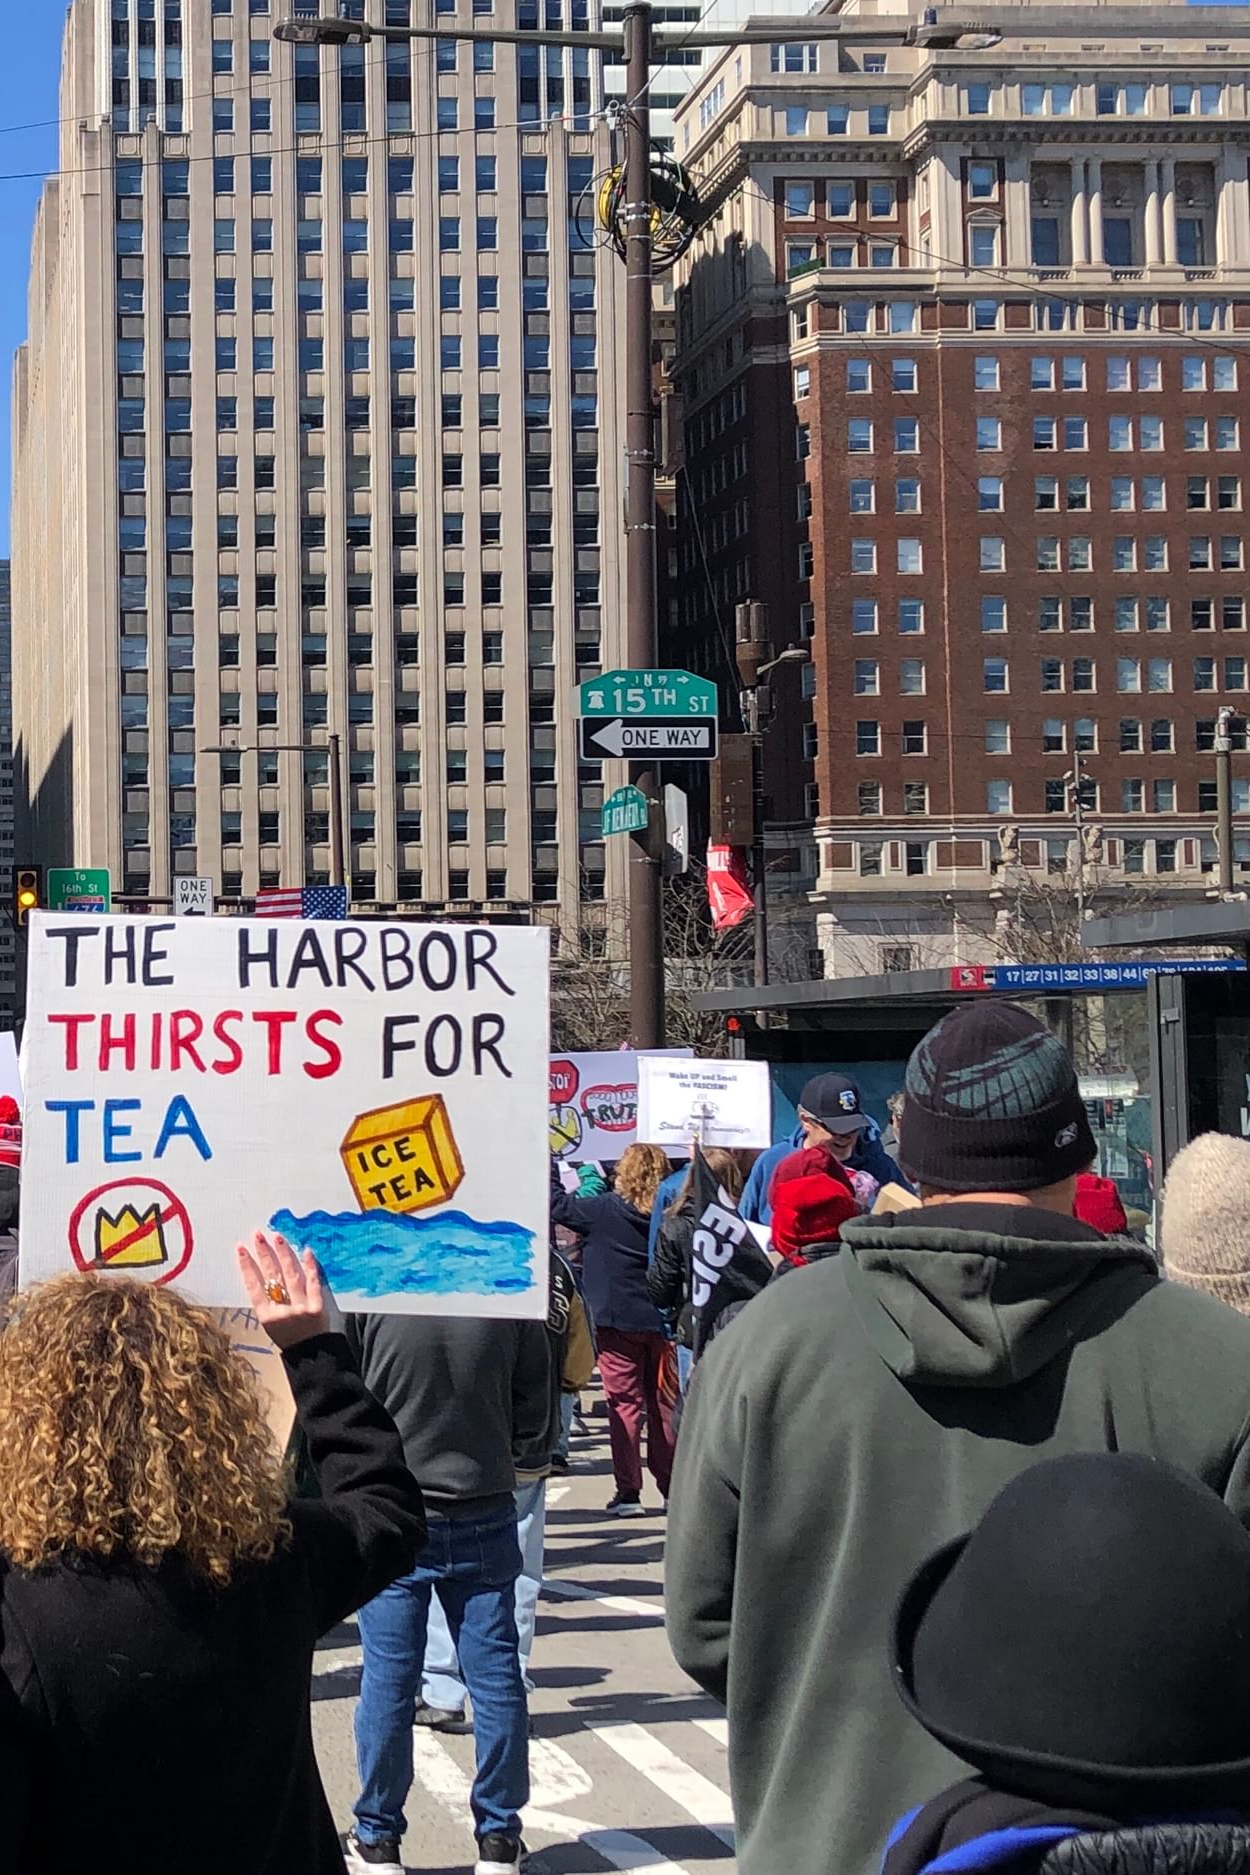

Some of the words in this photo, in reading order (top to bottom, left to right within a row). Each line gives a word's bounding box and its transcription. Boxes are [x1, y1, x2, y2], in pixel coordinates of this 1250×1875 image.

[613, 688, 677, 713] 15TH
[689, 696, 710, 713] ST
[622, 729, 660, 746] ONE
[666, 729, 702, 746] WAY
[62, 884, 82, 893] 16th
[88, 884, 98, 893] St
[75, 872, 86, 881] To
[180, 881, 207, 891] ONE
[179, 894, 207, 904] WAY
[45, 923, 176, 988] THE
[238, 926, 516, 996] HARBOR
[1007, 971, 1020, 982] 17
[1025, 971, 1040, 982] 27
[1045, 970, 1058, 981] 31
[1064, 970, 1079, 981] 32
[1084, 969, 1098, 981] 33
[1122, 968, 1137, 980] 44
[47, 1008, 343, 1080] THIRSTS
[381, 1013, 513, 1080] FOR
[581, 1102, 637, 1129] TRUT
[44, 1094, 213, 1165] TEA
[356, 1135, 416, 1174] ICE
[367, 1166, 436, 1207] TEA
